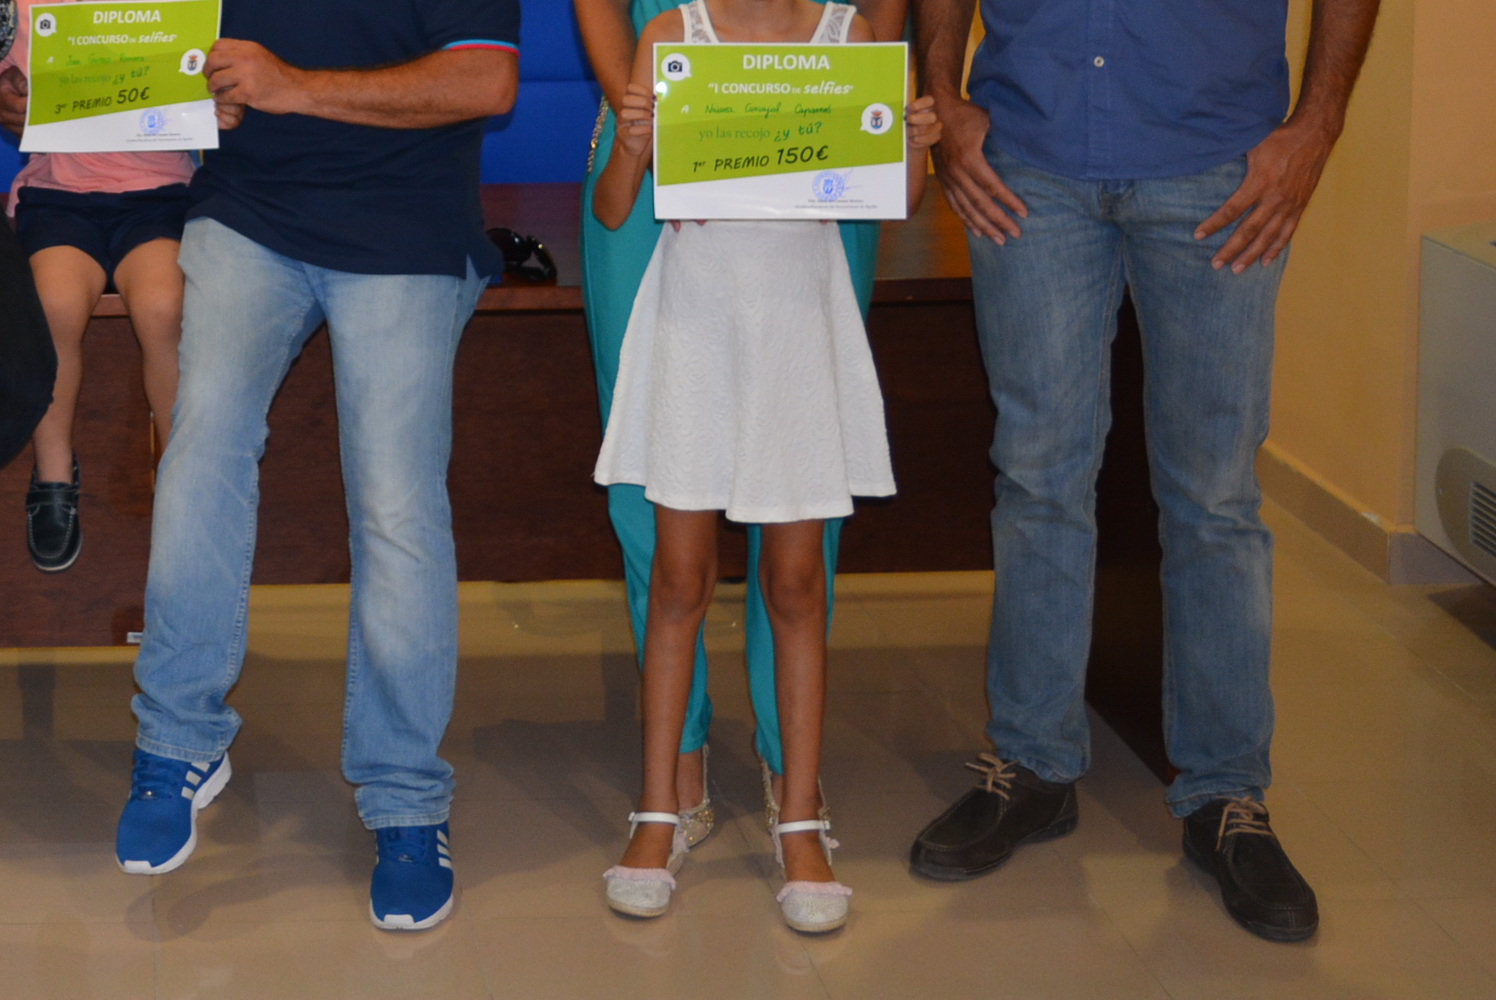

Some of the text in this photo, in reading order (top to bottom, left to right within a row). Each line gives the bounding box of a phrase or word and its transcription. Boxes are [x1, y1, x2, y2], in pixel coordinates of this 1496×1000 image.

[93, 10, 161, 24] DIPLOMA
[77, 34, 128, 46] CONCURSO
[743, 54, 830, 70] DIPLOMA
[130, 65, 151, 78] tú?
[721, 82, 791, 94] CONCURSO
[72, 96, 112, 112] PREMIO
[117, 86, 150, 104] 50€
[681, 105, 689, 114] A
[699, 121, 822, 142] yo las recojo ¿y tú?
[714, 155, 769, 171] PREMIO
[777, 145, 829, 165] 150€
